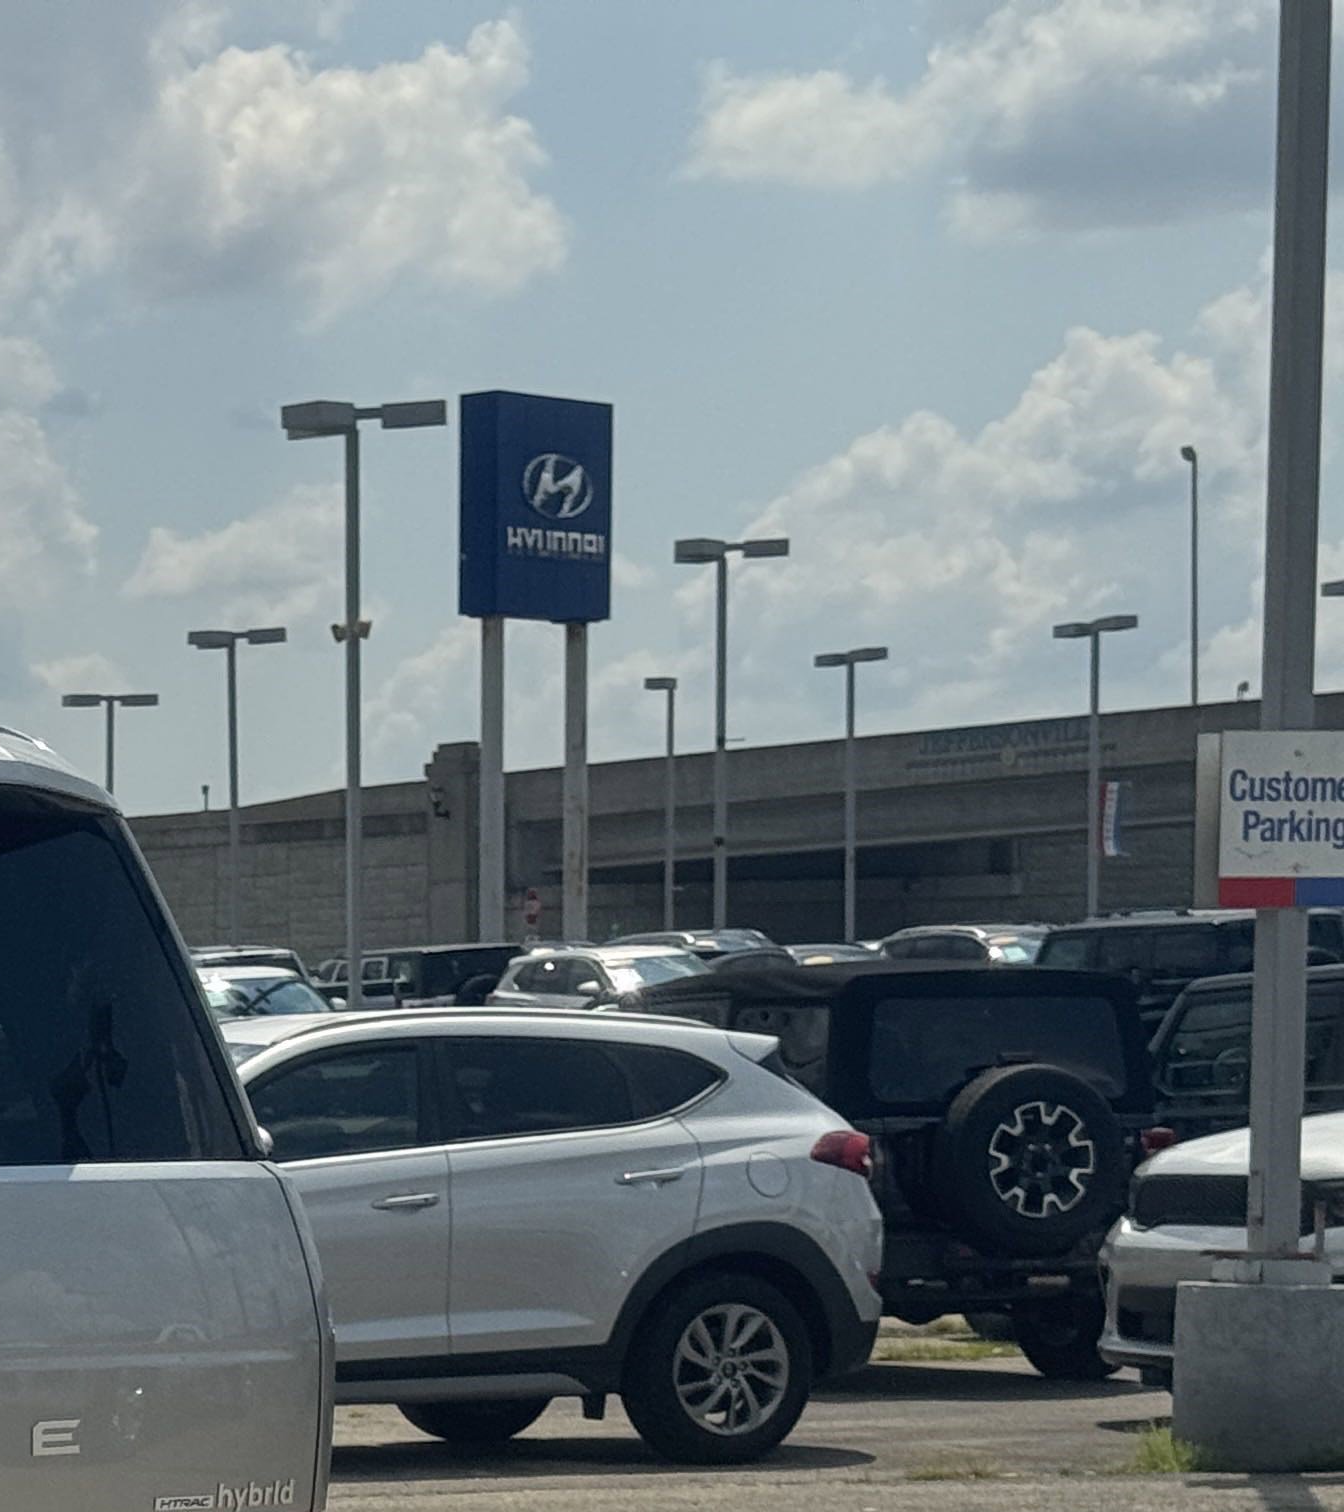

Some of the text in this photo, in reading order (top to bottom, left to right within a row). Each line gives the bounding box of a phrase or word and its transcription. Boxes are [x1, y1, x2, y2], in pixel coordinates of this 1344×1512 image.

[507, 526, 606, 555] HYUNDAI
[918, 720, 1092, 754] JEFFERSONVILL
[1242, 809, 1344, 849] Parking
[217, 1477, 296, 1512] hybrid
